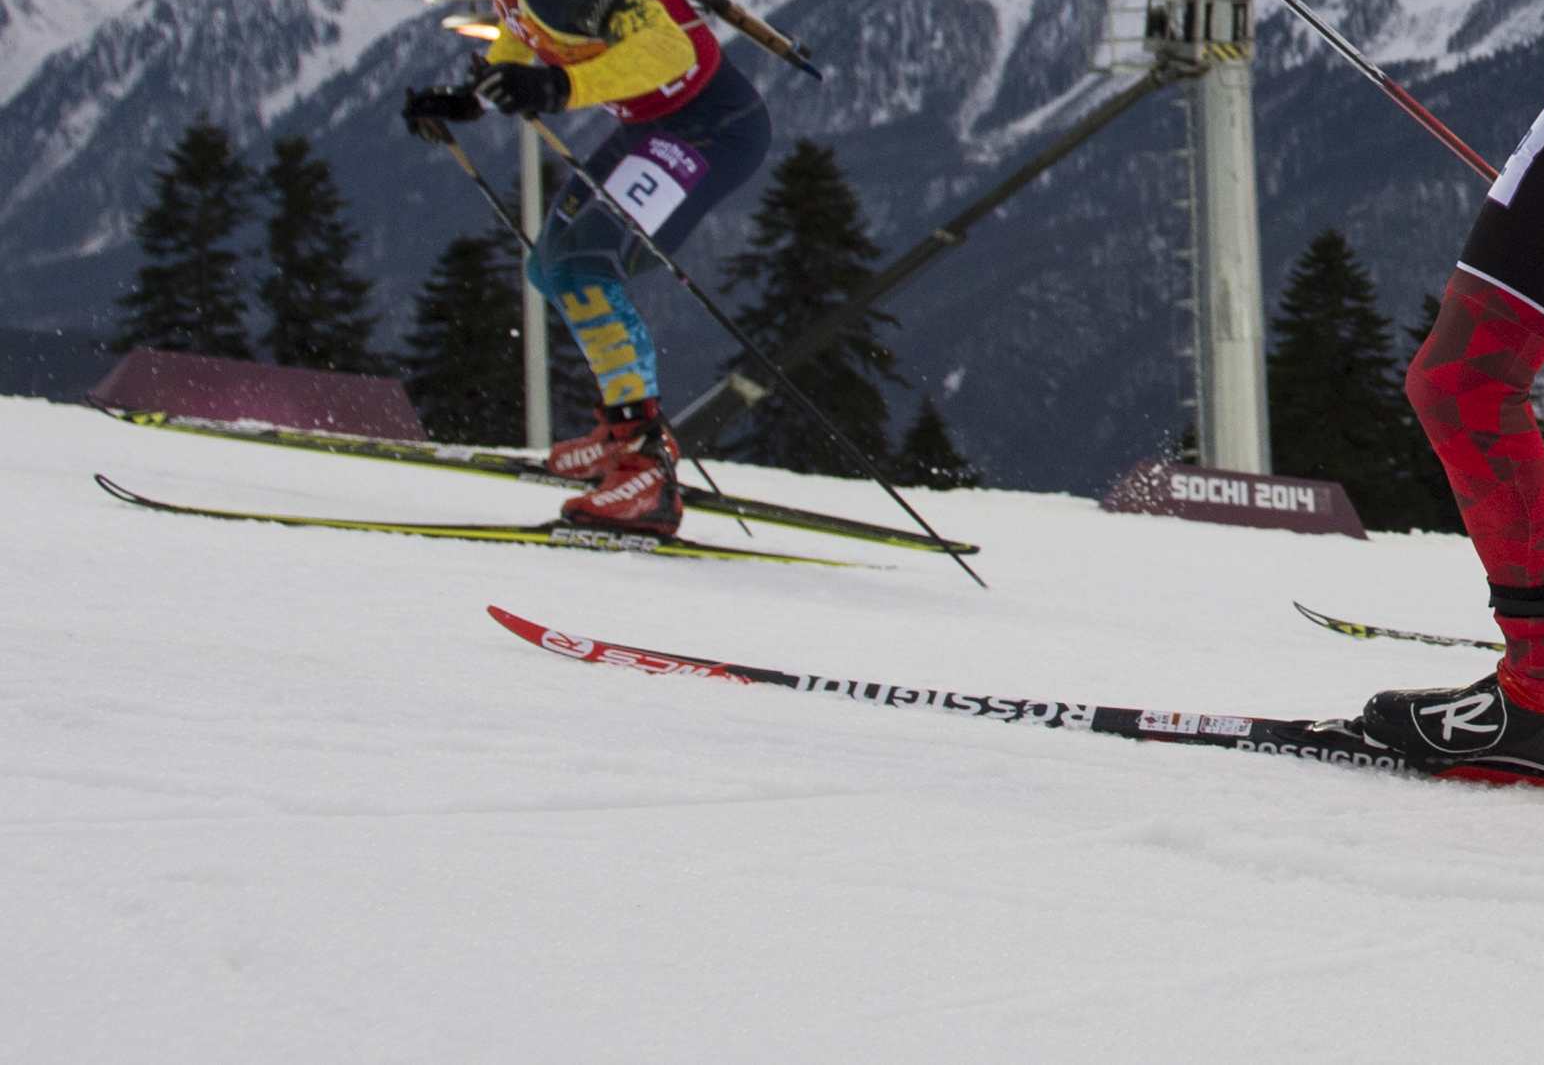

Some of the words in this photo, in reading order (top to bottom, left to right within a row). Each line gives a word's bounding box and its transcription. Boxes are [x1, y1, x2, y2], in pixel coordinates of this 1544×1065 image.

[626, 171, 658, 207] 2
[1169, 474, 1250, 507] SOCHI
[1254, 482, 1316, 514] 2014
[551, 527, 661, 553] FISCHER
